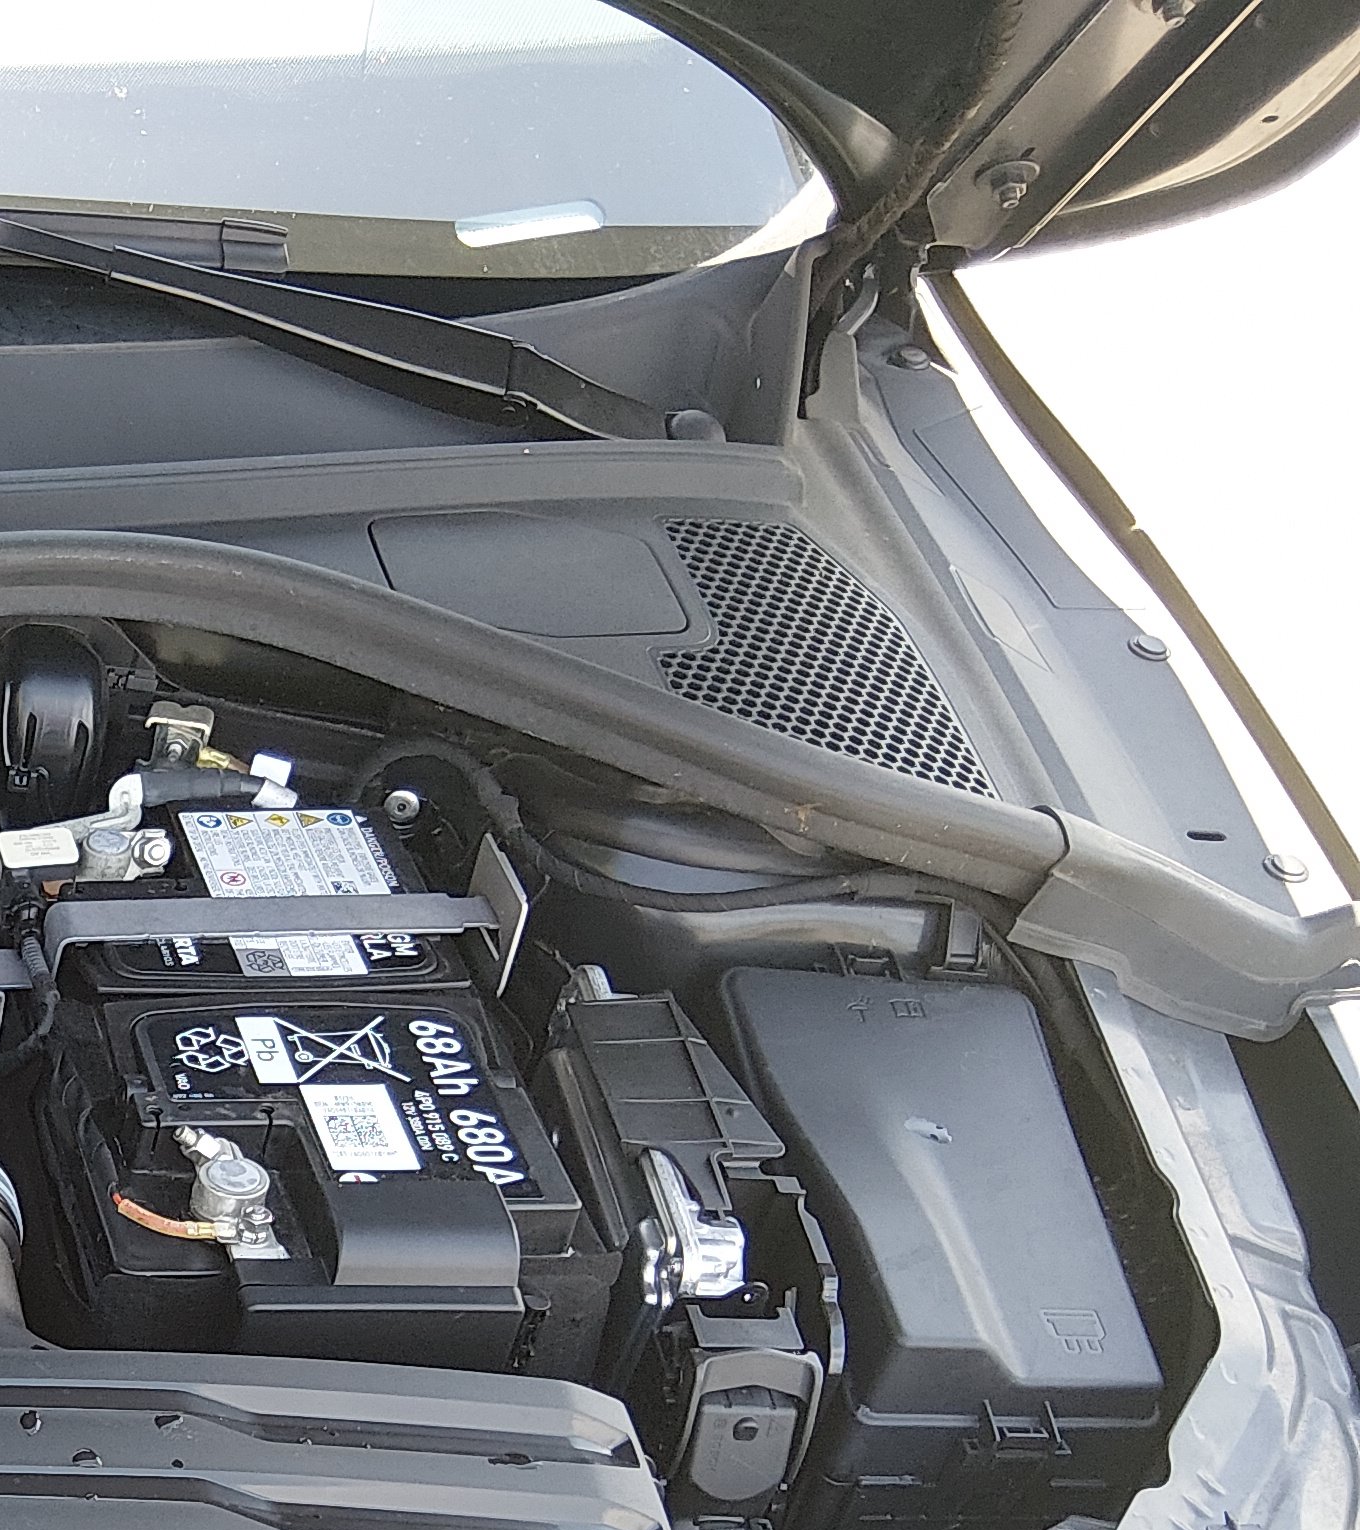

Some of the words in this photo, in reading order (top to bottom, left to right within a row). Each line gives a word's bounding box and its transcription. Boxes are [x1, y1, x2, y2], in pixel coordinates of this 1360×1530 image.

[251, 1038, 279, 1061] Pb
[408, 1020, 479, 1096] 68Ah
[449, 1108, 525, 1186] 680A
[422, 1112, 445, 1131] 915
[441, 1153, 460, 1162] C
